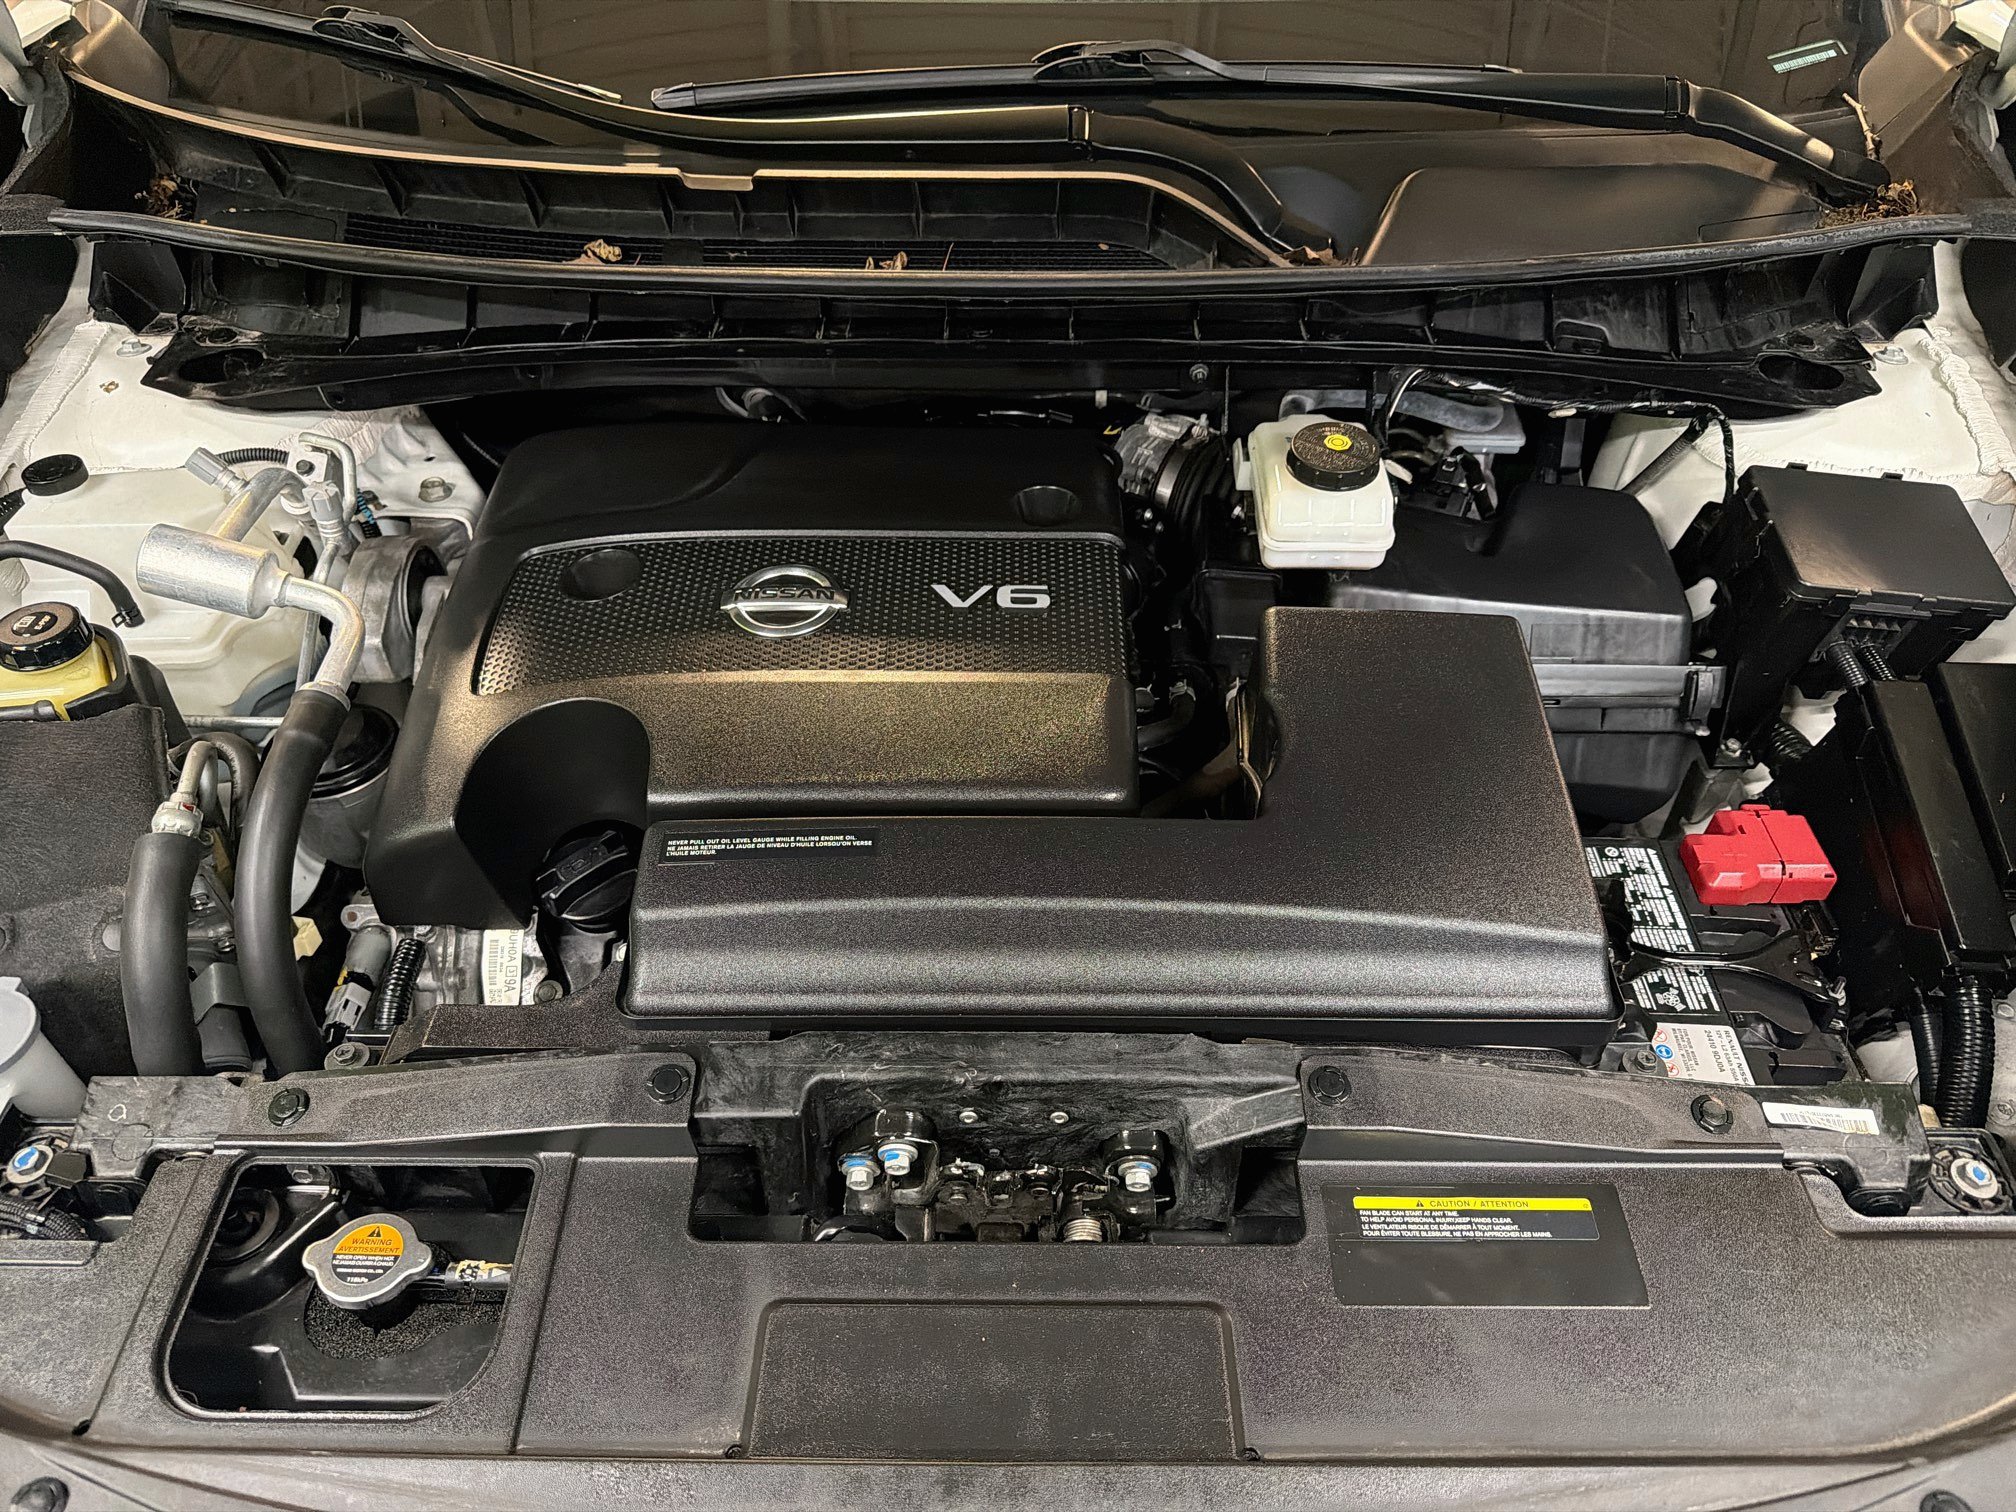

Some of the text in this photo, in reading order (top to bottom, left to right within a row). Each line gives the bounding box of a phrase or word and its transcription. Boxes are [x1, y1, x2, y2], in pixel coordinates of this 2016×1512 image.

[734, 587, 835, 600] NISSAN
[930, 584, 1050, 608] V6
[1704, 1030, 1716, 1049] 24410
[1724, 1030, 1740, 1060] RENAULT
